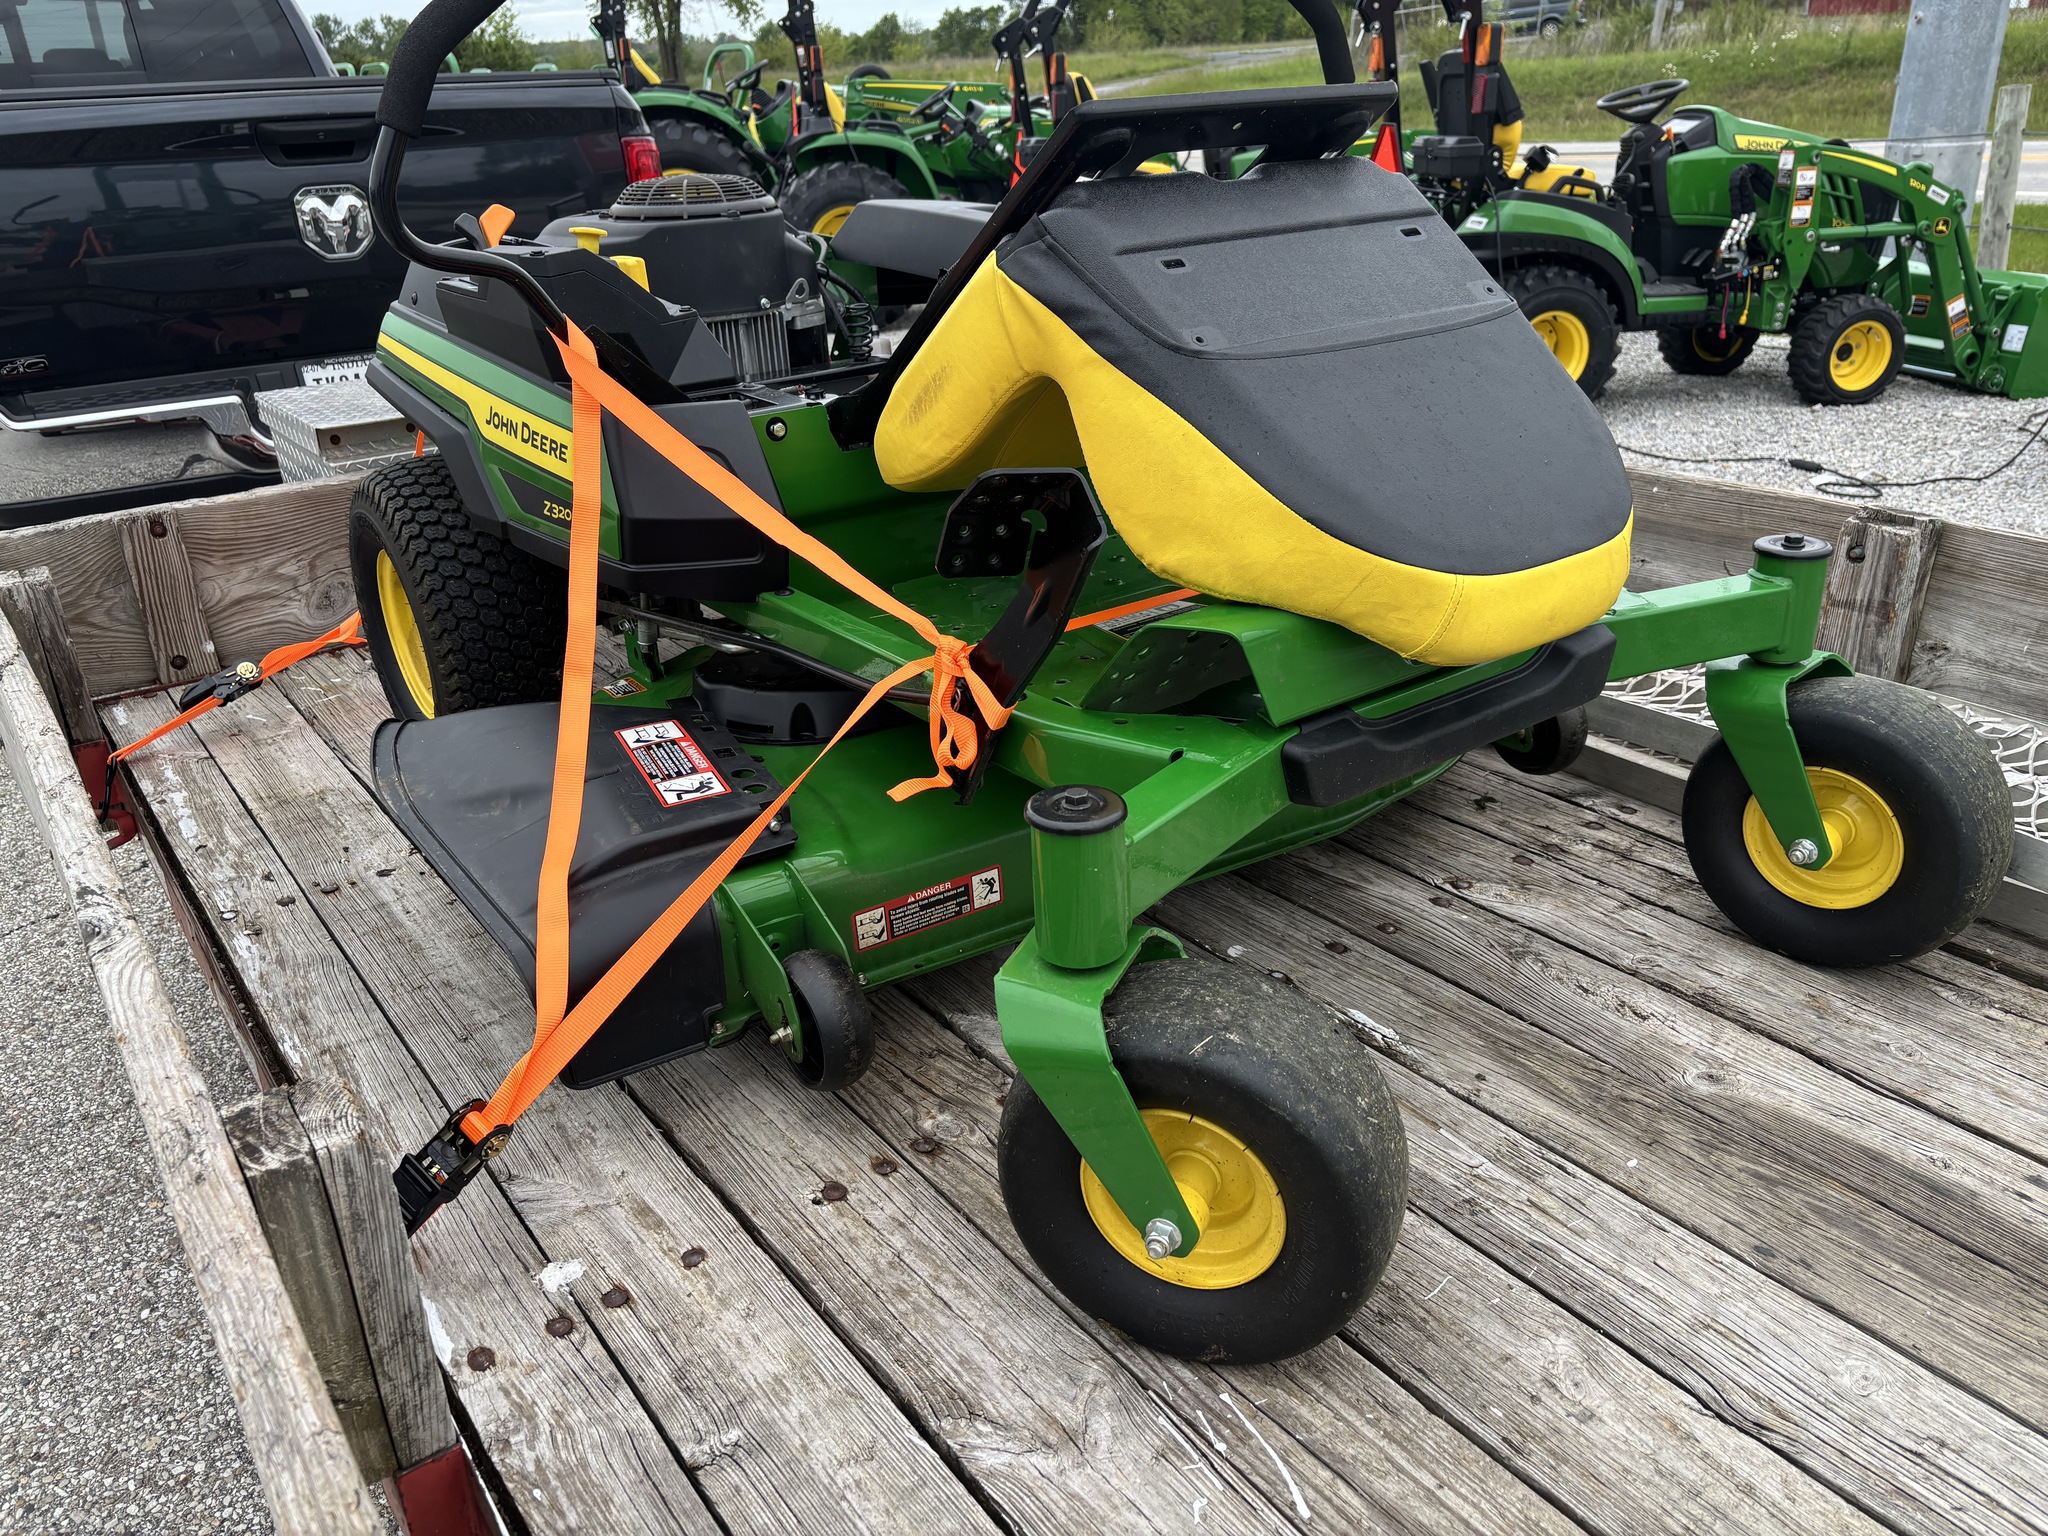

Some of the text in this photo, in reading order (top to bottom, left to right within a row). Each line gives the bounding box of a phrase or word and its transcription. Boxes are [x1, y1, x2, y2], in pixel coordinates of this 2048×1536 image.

[1744, 139, 1774, 150] JOHN
[486, 406, 568, 464] JOHN DEERE
[544, 500, 572, 520] Z320
[688, 745, 709, 769] DANGER
[916, 882, 952, 900] DANGER
